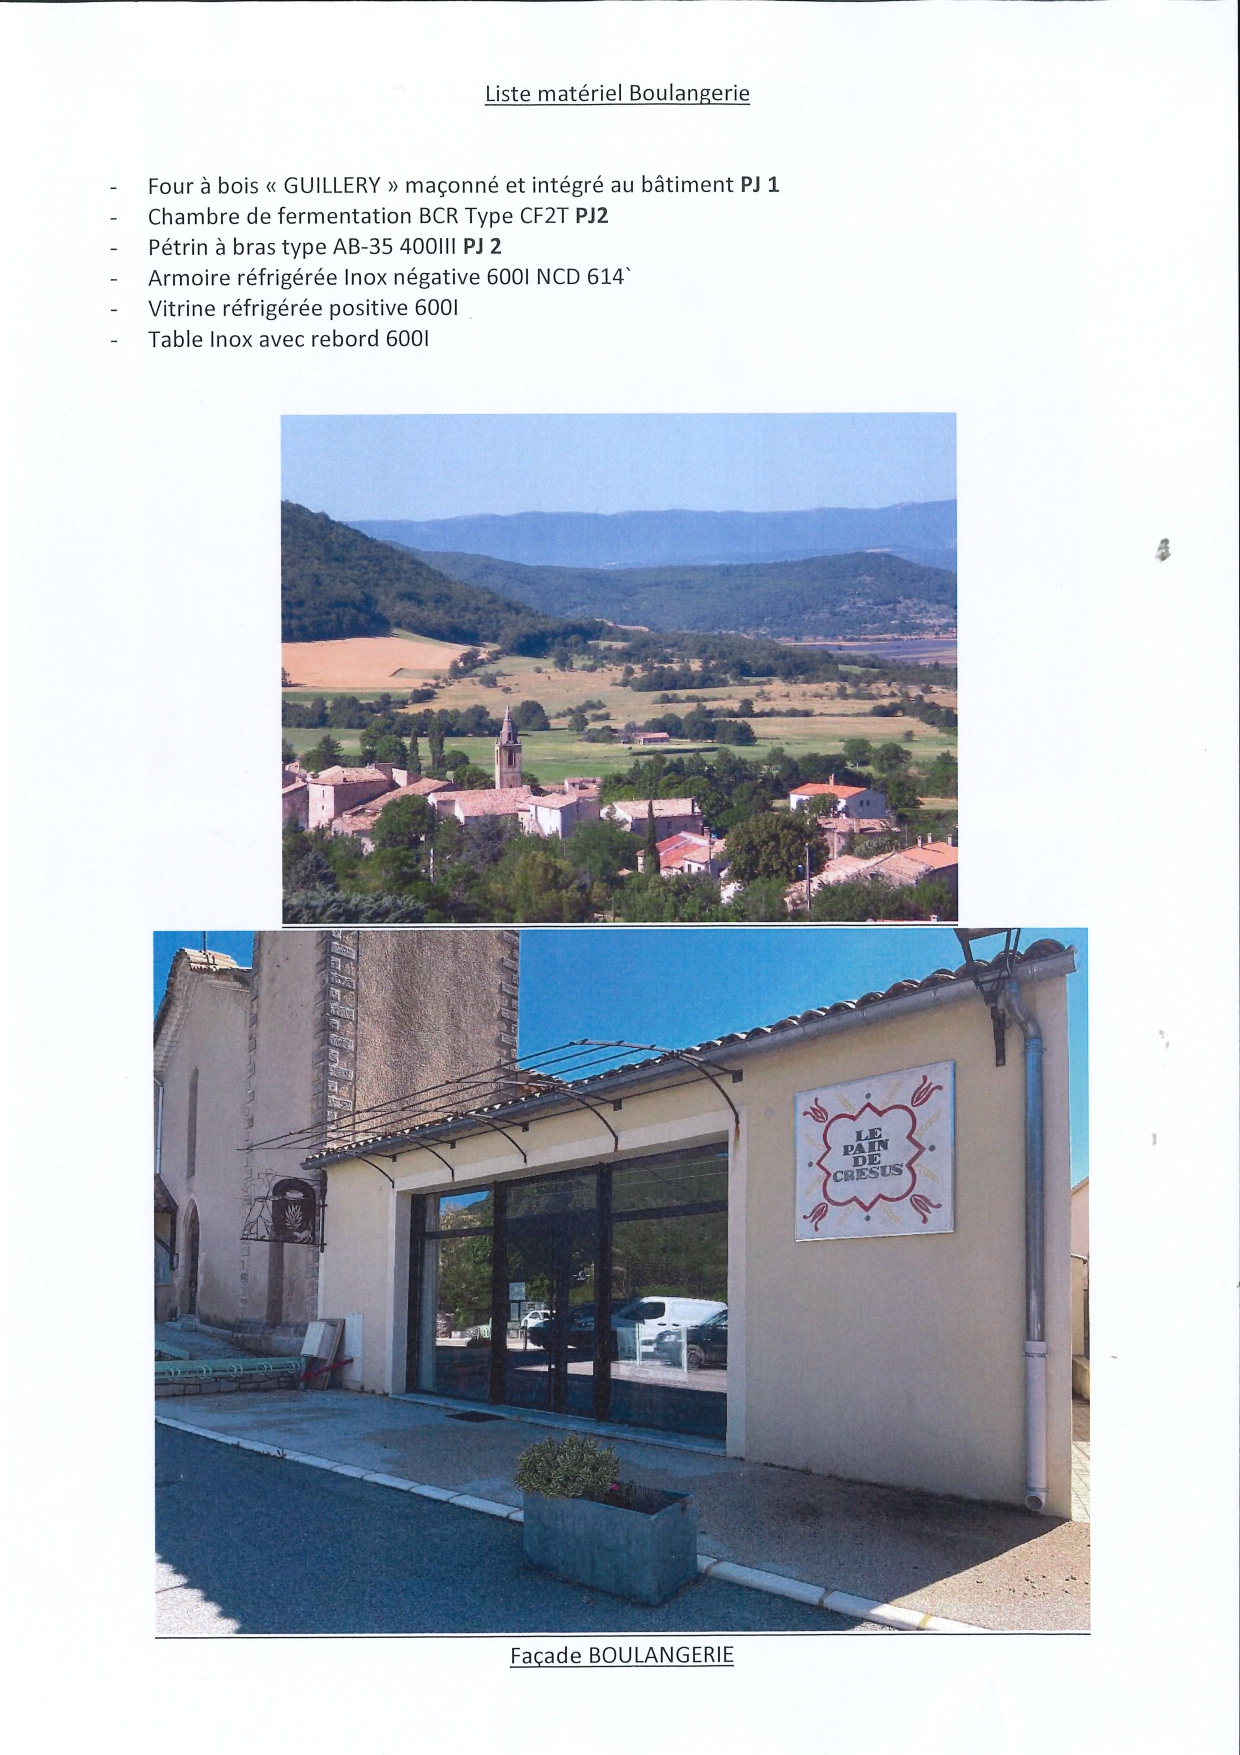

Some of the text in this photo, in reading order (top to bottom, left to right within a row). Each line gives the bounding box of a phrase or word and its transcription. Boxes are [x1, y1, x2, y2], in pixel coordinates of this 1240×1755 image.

[485, 83, 750, 104] Liste matériel Boulangerie
[150, 178, 194, 194] Four
[201, 177, 210, 194] à
[219, 176, 258, 194] bois
[285, 177, 380, 193] GUILLERY
[407, 176, 498, 197] maçonné
[507, 178, 525, 193] et
[533, 175, 603, 197] intégré
[612, 181, 633, 192] au
[643, 175, 733, 192] bâtiment
[742, 176, 759, 192] PJ
[769, 176, 779, 192] 1
[149, 207, 608, 228] Chambre de fermentation BCR Type CF2T PJ2
[150, 238, 207, 255] Pétrin
[216, 238, 225, 255] à
[234, 238, 275, 255] bras
[282, 240, 326, 259] type
[333, 238, 392, 254] AB-35
[464, 238, 482, 254] PJ
[491, 238, 501, 254] 2
[149, 269, 230, 286] Armoire
[238, 268, 337, 290] réfrigérée
[346, 269, 386, 285] Inox
[395, 267, 480, 289] négative
[538, 268, 579, 284] NCD
[149, 300, 215, 316] Vitrine
[224, 299, 322, 320] réfrigérée
[330, 299, 407, 320] positive
[148, 330, 202, 347] Table
[211, 331, 252, 347] Inox
[260, 335, 304, 347] avec
[312, 329, 378, 347] rebord
[855, 1127, 882, 1142] LE
[843, 1138, 889, 1156] PAIN
[852, 1153, 881, 1167] DE
[832, 1163, 903, 1182] CRESUS
[511, 1646, 734, 1666] Façade BOULANGERIE
